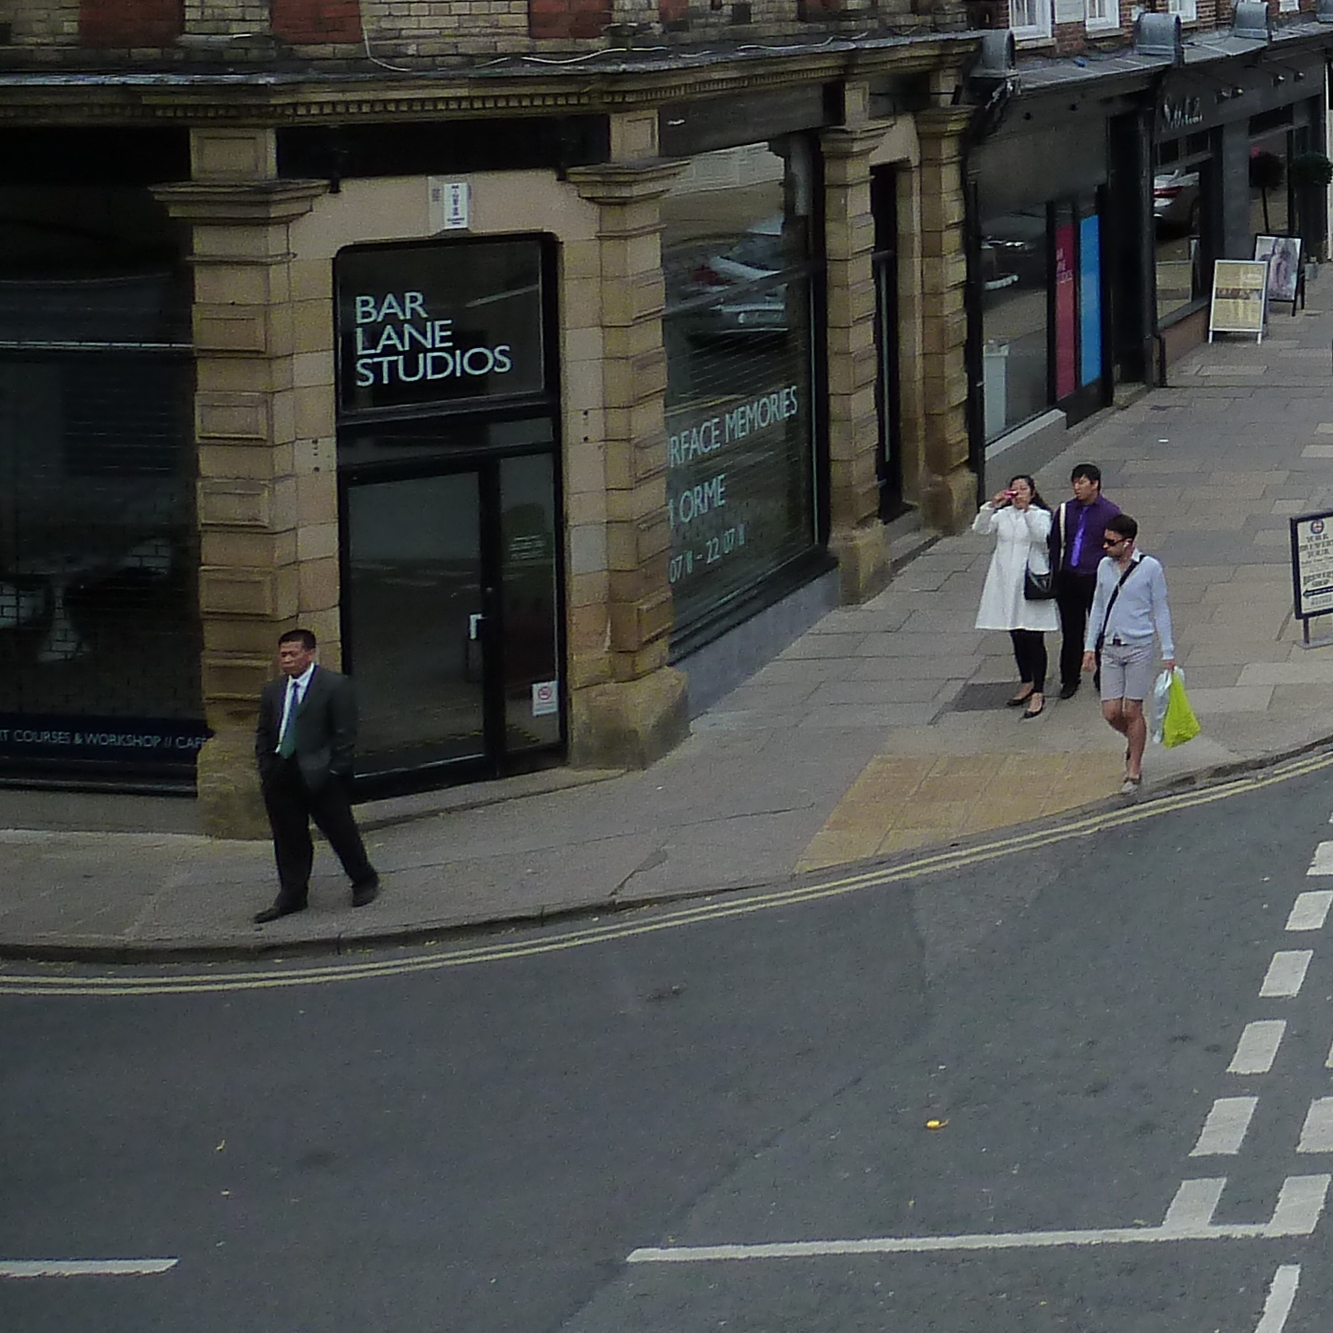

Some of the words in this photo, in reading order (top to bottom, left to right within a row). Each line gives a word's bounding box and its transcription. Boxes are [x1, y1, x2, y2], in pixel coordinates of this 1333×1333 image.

[355, 291, 429, 324] BAR
[355, 319, 454, 356] LANE
[355, 345, 512, 387] STUDIOS
[725, 385, 798, 444] MEMORIES
[679, 474, 726, 523] ORME
[13, 729, 71, 745] COURSES
[74, 732, 84, 745] &
[85, 733, 162, 748] WORKSHOP
